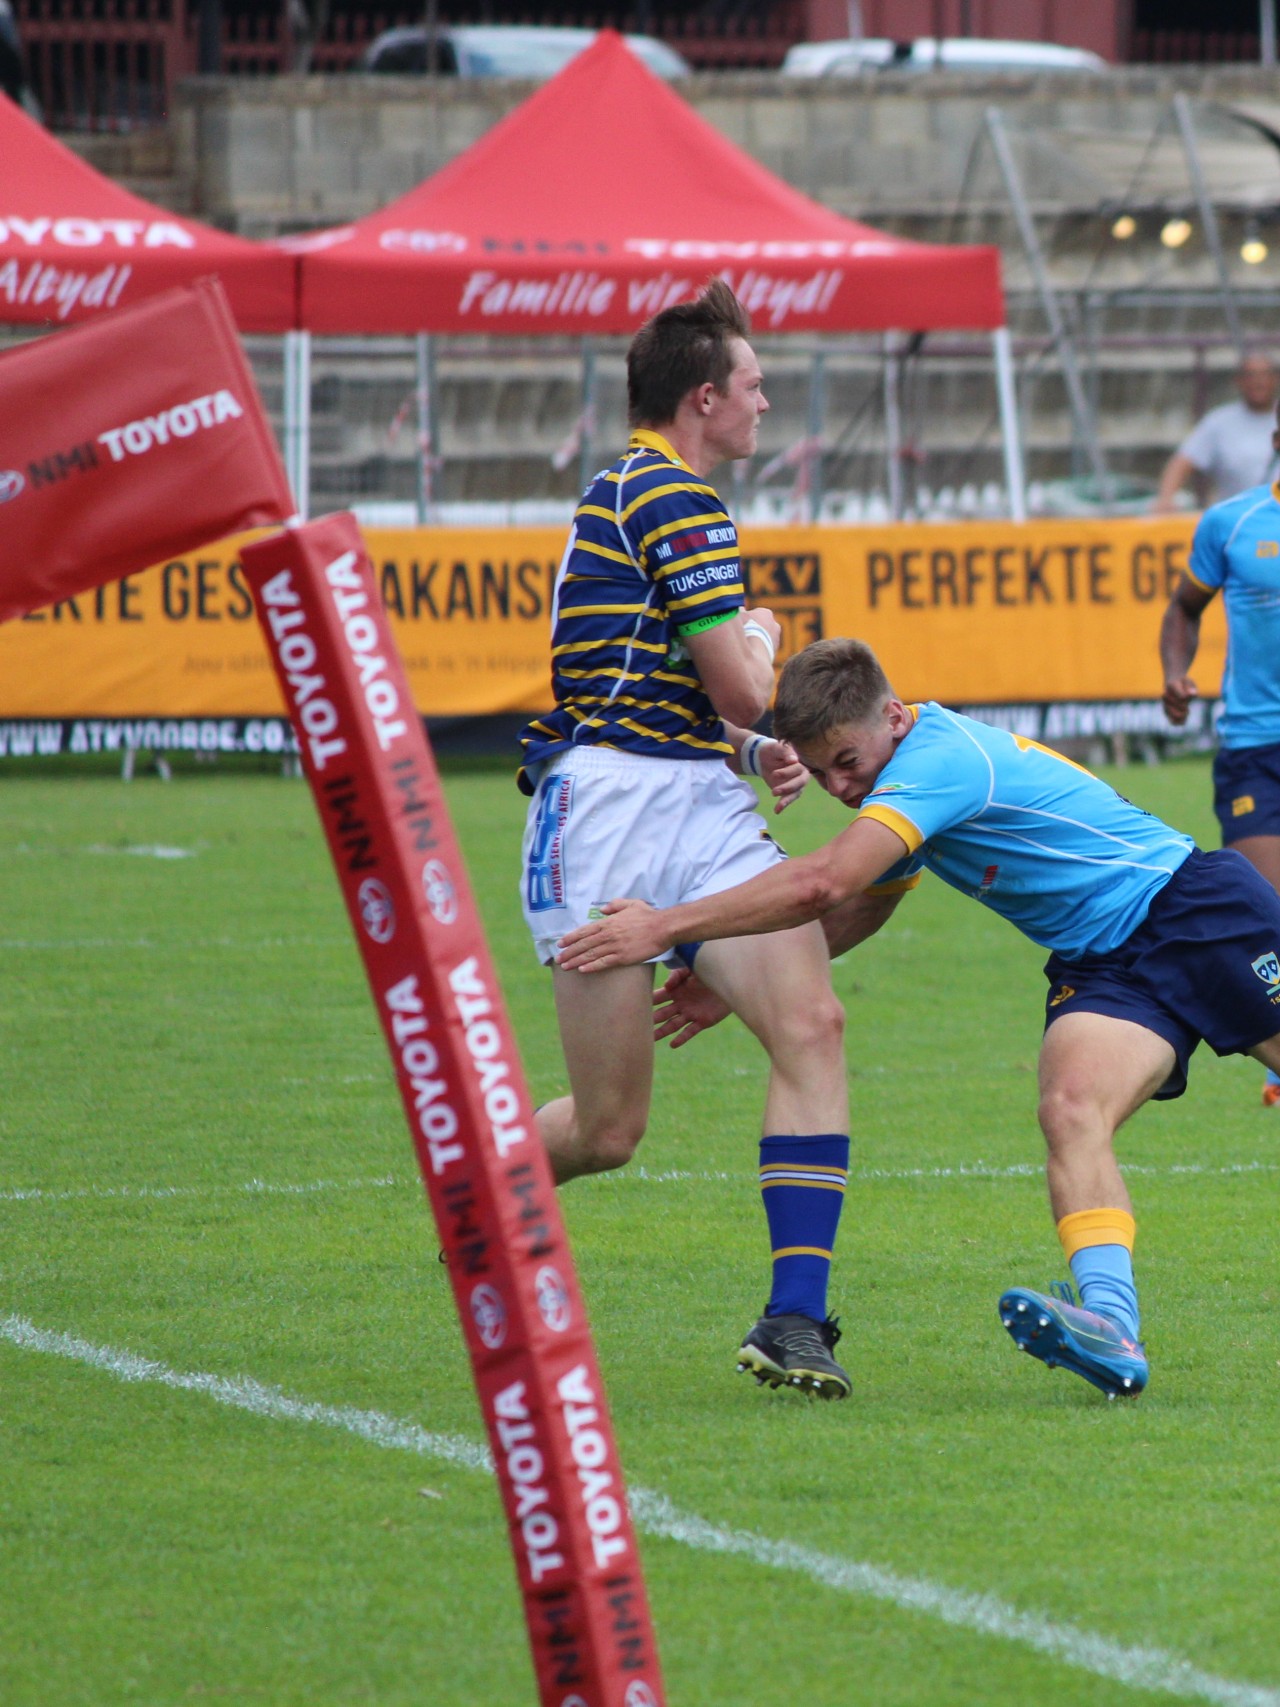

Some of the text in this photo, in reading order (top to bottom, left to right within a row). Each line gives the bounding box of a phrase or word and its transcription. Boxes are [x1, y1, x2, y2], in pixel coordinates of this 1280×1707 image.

[0, 216, 195, 249] YOTA
[458, 270, 616, 316] Familie
[98, 388, 243, 462] TOYOTA
[867, 544, 1115, 609] PERFEKTE
[261, 568, 378, 872] NMI TOYOTA
[325, 550, 438, 854] NMI TOYOTA
[558, 779, 571, 812] AFRICA
[385, 973, 493, 1277] NMI TOYOTA
[448, 955, 556, 1259] NMI TOYOTA
[493, 1380, 583, 1686] NMI TOYOTA
[556, 1363, 646, 1671] NMI TOYOTA
